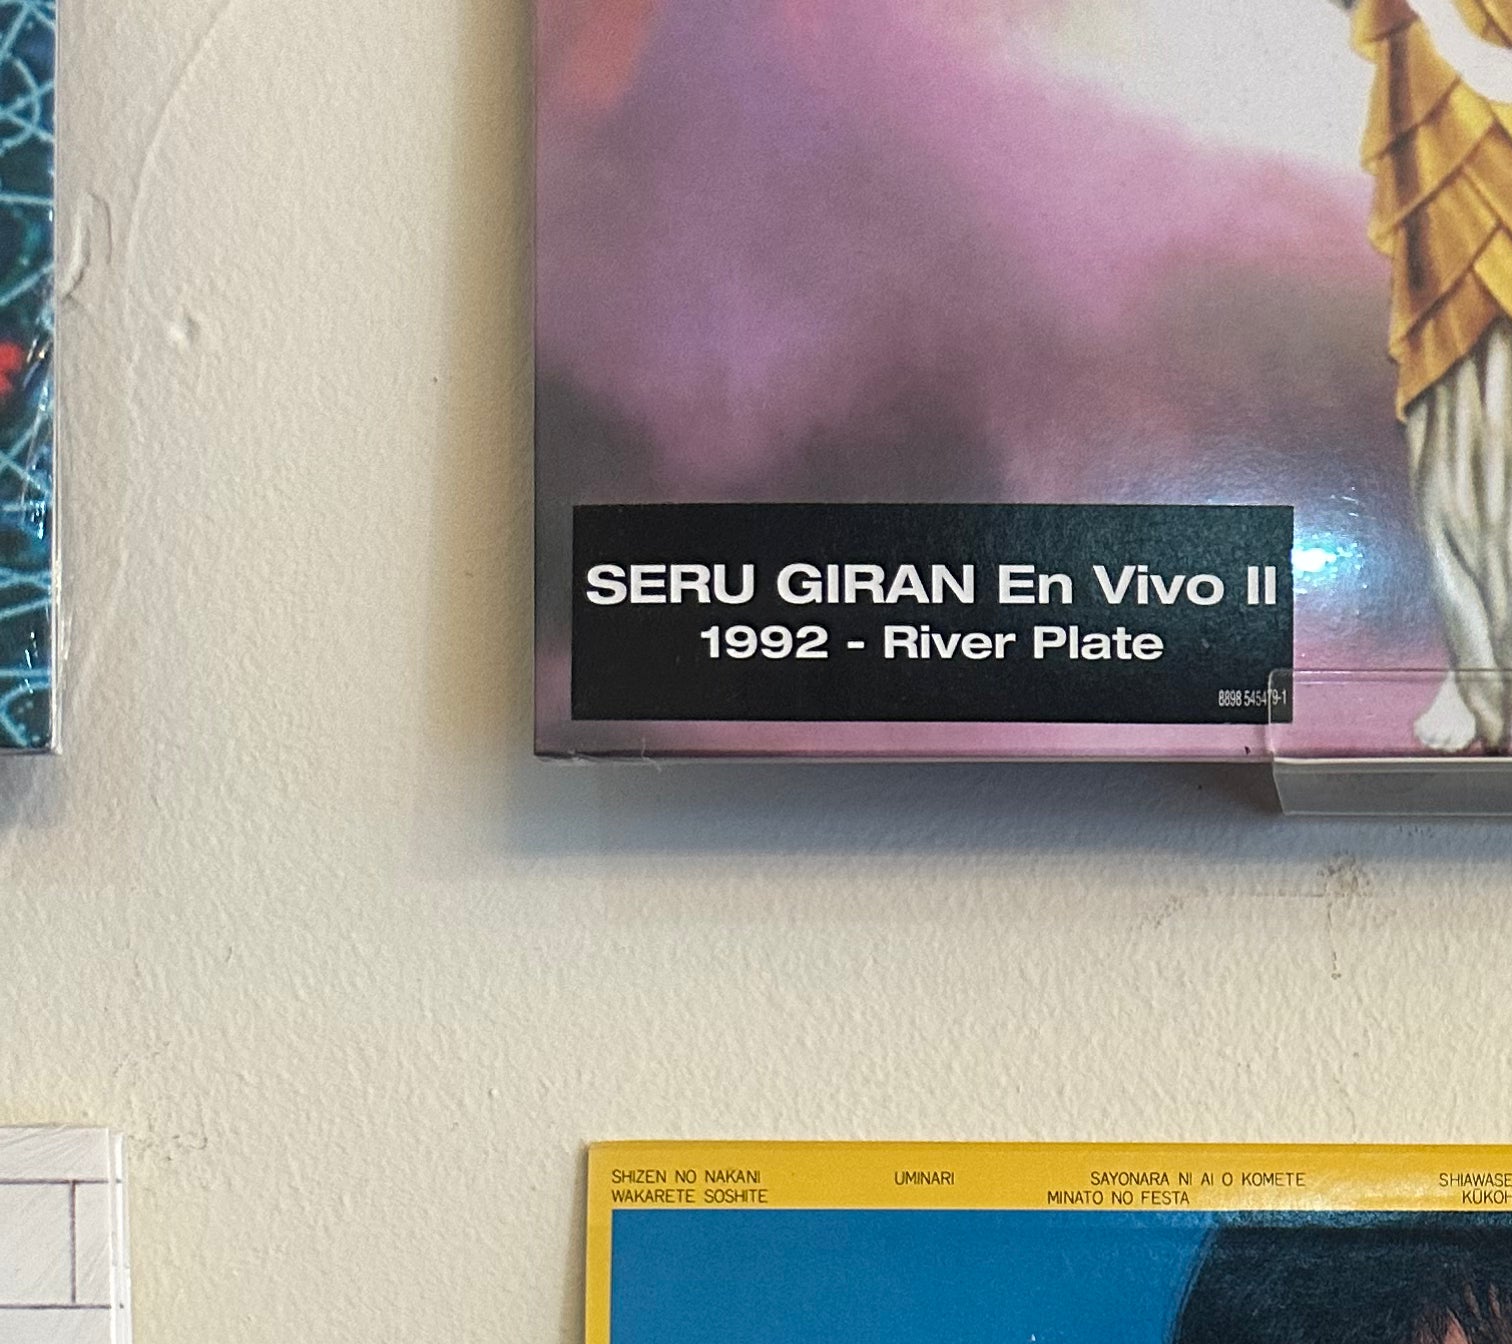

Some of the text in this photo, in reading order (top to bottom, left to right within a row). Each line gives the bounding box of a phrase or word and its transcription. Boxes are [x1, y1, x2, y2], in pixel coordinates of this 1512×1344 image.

[586, 564, 1277, 606] SERU GIRAN En Vivo II
[700, 625, 1165, 661] 1992 - River Plate
[1218, 689, 1242, 707] 8898
[611, 1168, 761, 1184] SHIZEN NO NAKANI
[894, 1170, 955, 1186] UMINARI
[1090, 1170, 1306, 1187] SAYONARA NI AI O KOMETE
[611, 1188, 769, 1204] WAKARETE SOSHITE
[1047, 1190, 1190, 1206] MINATO NO FESTA
